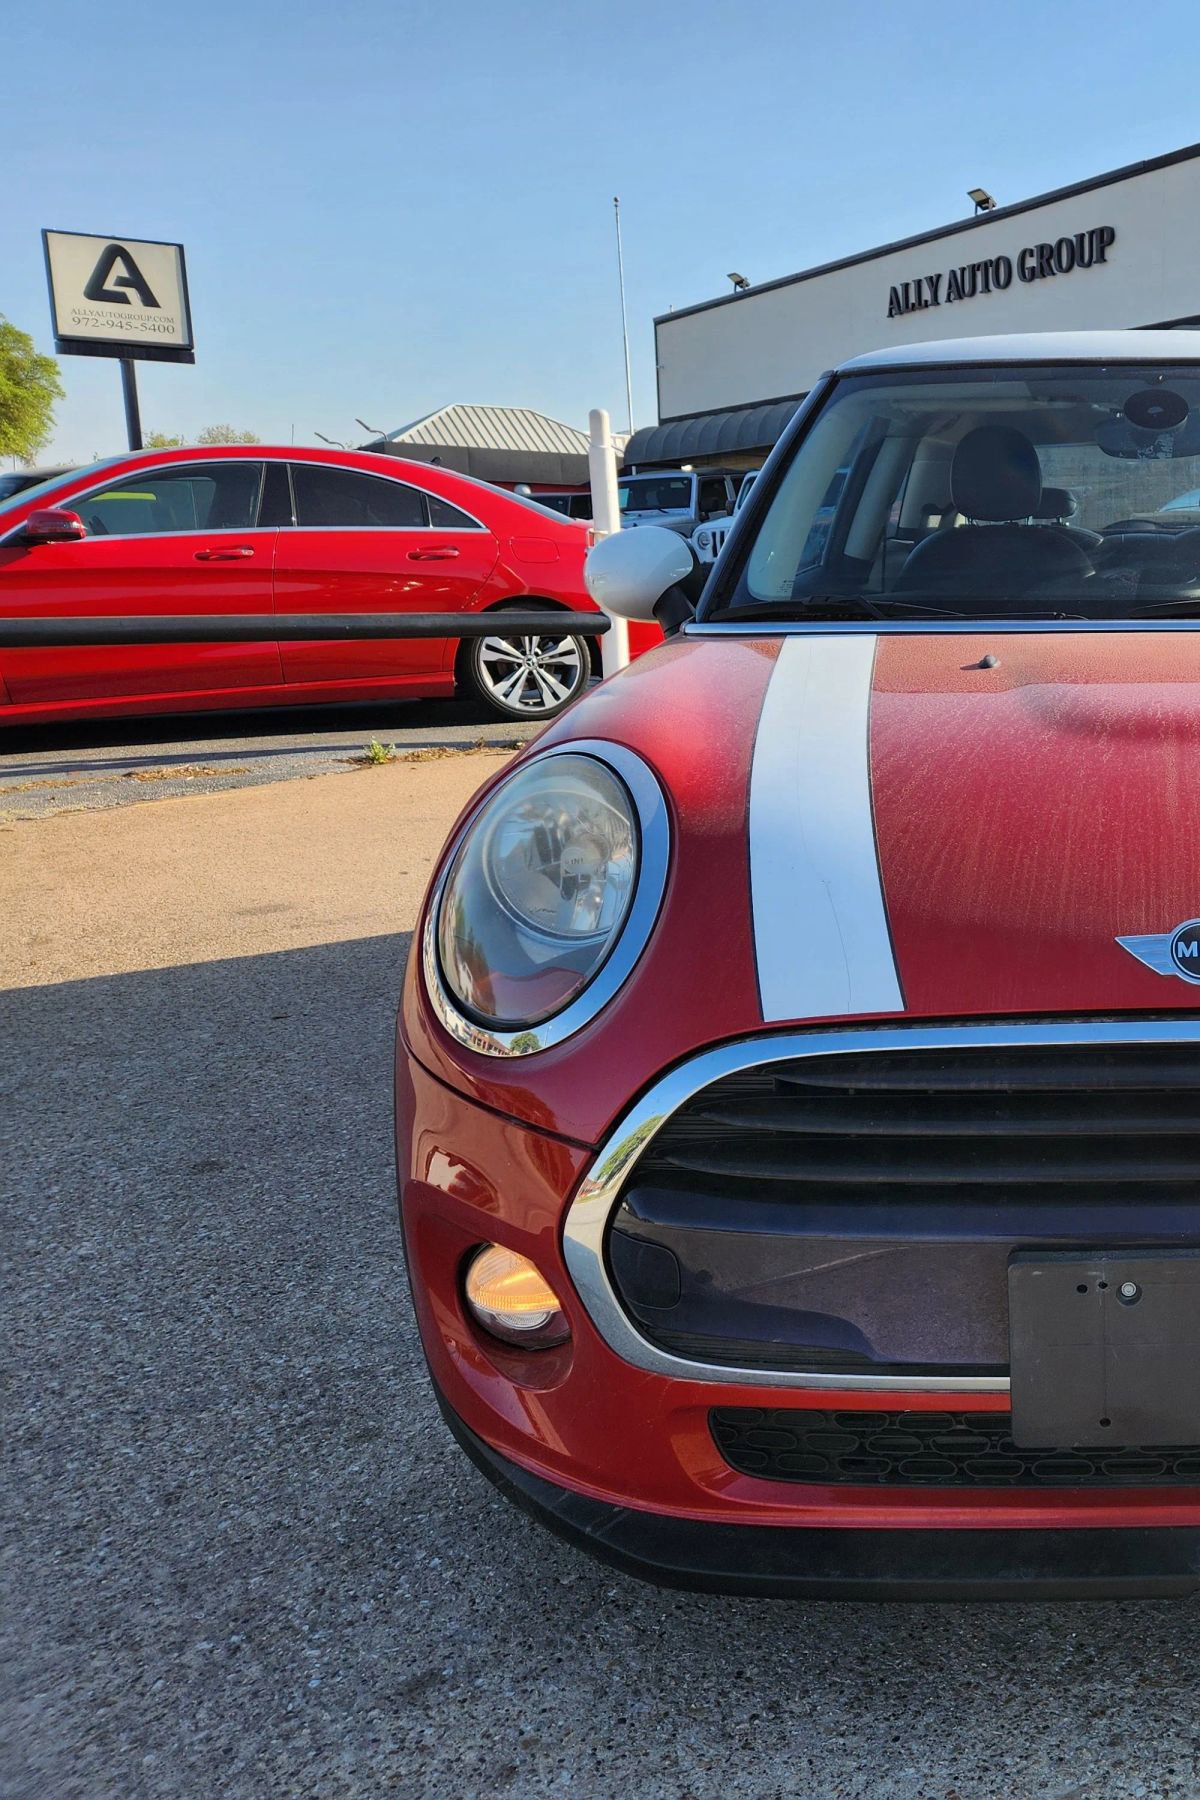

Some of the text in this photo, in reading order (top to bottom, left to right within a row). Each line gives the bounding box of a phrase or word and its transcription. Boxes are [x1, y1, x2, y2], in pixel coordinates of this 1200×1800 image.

[887, 226, 1115, 318] ALLY AUTO GROUP
[71, 308, 175, 324] ALLYAUTOGROUP.COM
[72, 317, 175, 334] 972-945-5400
